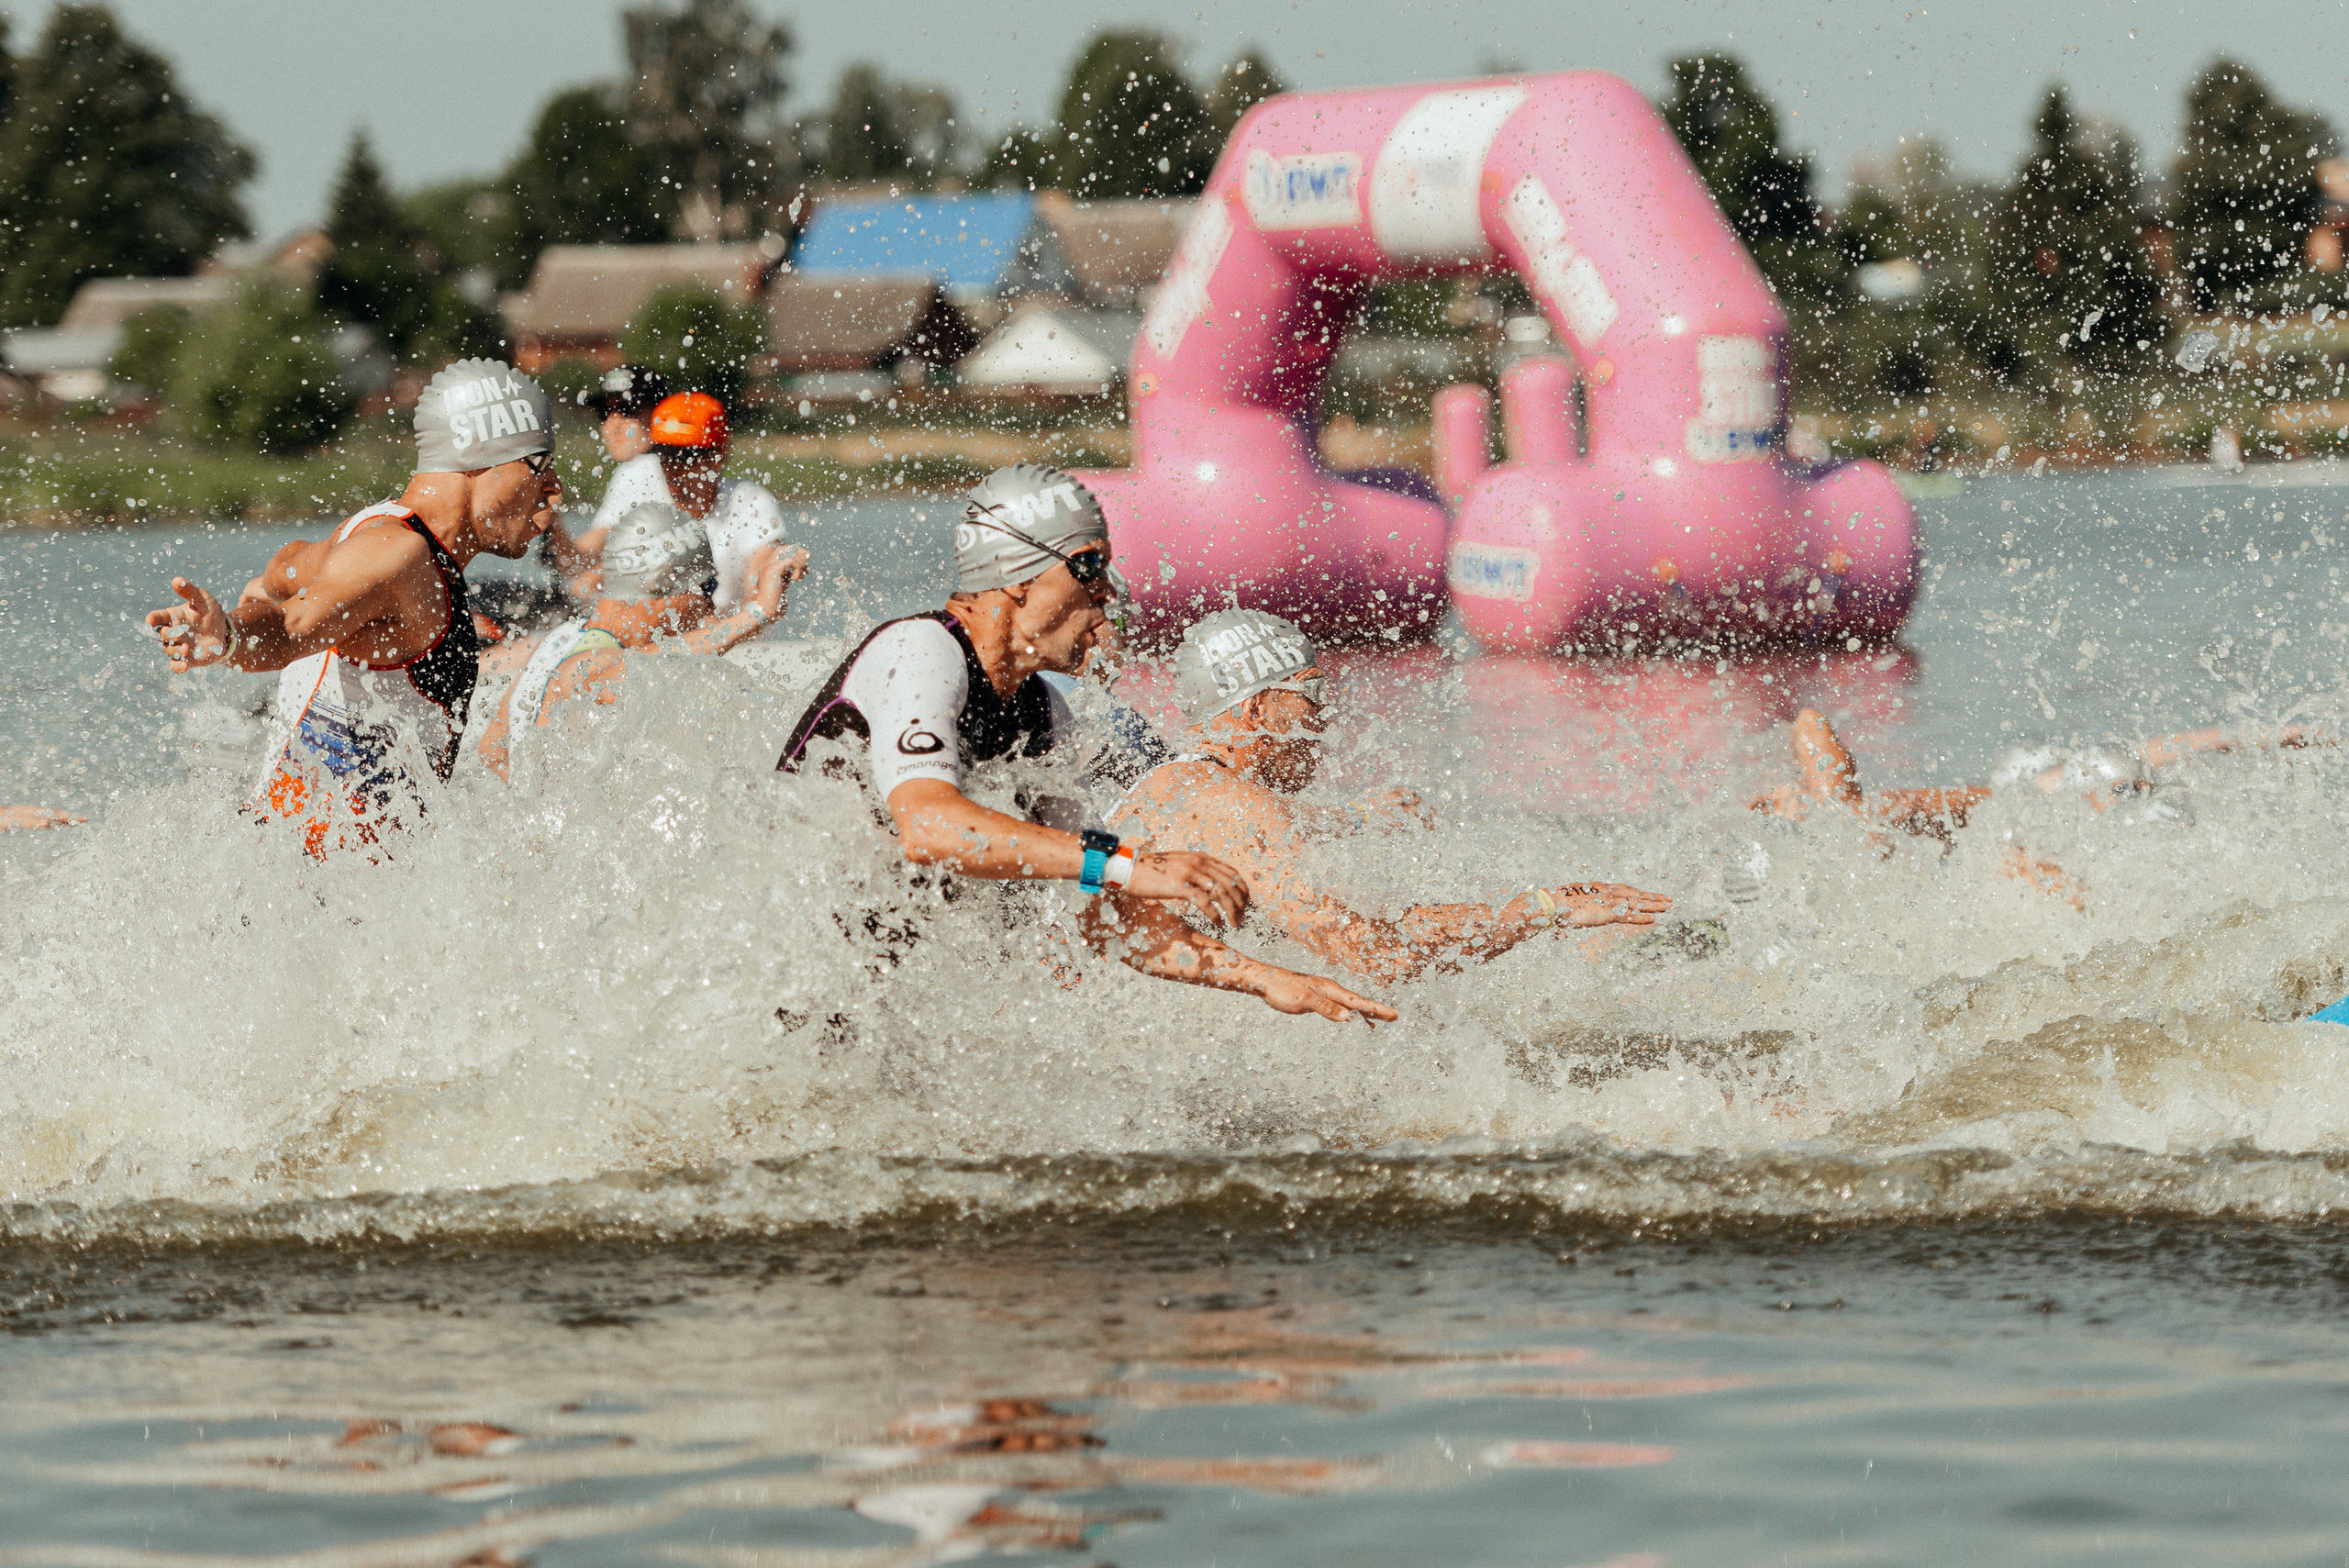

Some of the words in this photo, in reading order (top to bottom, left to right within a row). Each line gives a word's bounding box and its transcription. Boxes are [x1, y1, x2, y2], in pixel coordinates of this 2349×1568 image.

[443, 376, 505, 414] IRON
[450, 399, 540, 450] STAR
[1198, 623, 1262, 667] IRON
[1211, 637, 1307, 697] STAR
